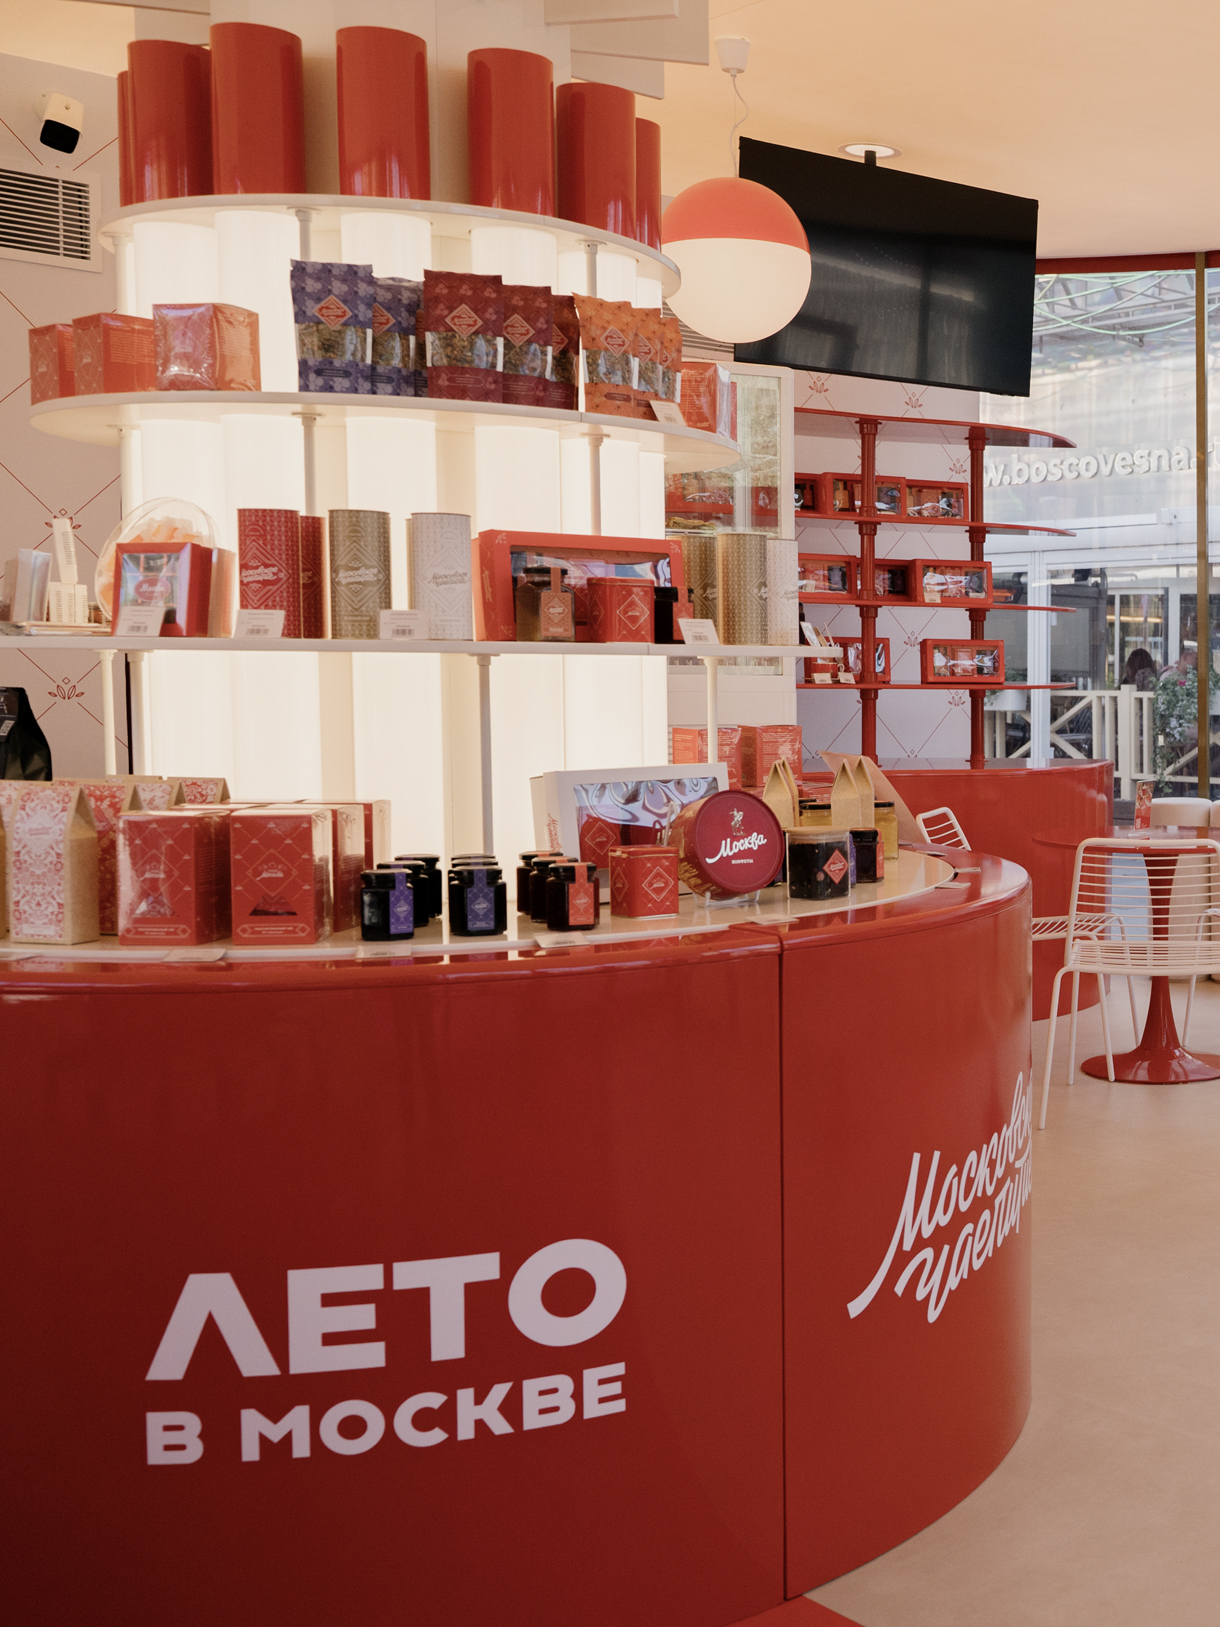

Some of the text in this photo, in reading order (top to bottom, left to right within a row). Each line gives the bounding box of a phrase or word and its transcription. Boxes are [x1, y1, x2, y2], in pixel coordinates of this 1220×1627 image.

[705, 832, 767, 864] Москва
[847, 1069, 1032, 1320] Московск
[144, 1238, 628, 1381] ЛЕТО
[146, 1361, 626, 1466] В МОСКВЕ
